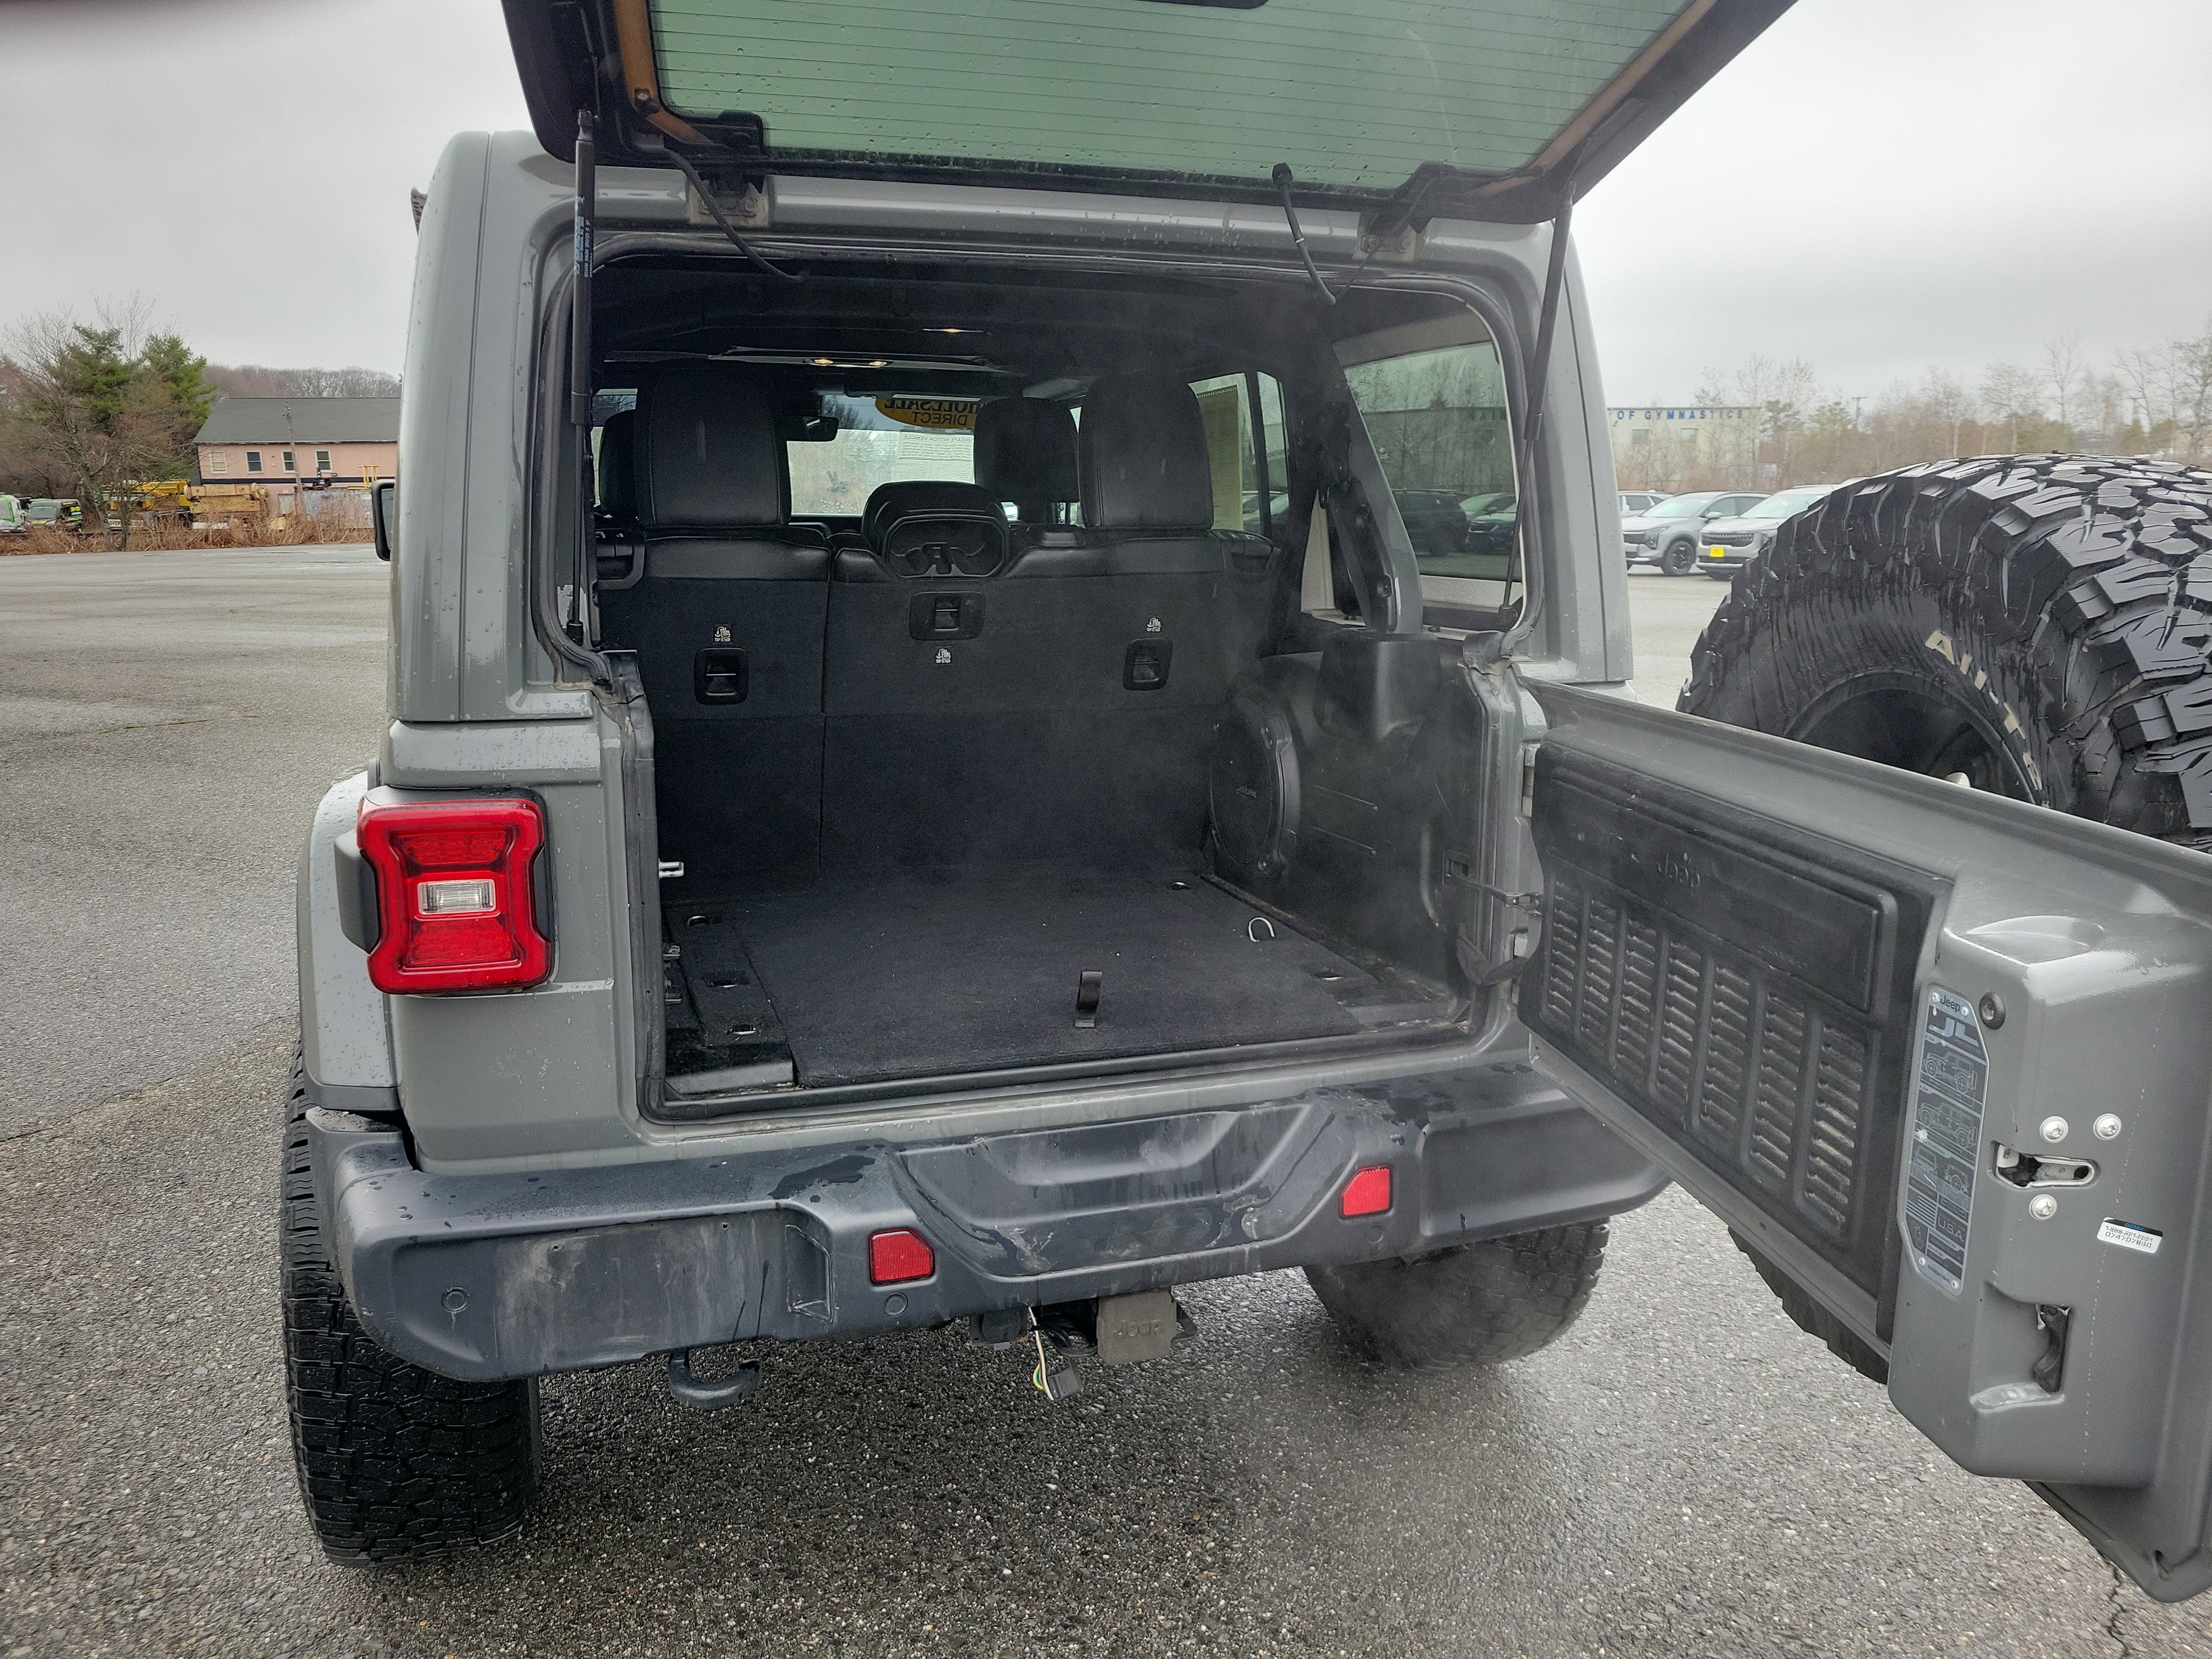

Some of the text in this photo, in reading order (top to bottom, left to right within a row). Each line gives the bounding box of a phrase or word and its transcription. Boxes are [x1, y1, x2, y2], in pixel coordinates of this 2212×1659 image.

[1617, 410, 1743, 420] OF GYMNASTICS
[1657, 851, 1701, 891] Jeep
[1940, 995, 1961, 1013] Jeep
[1928, 1017, 1980, 1048] JL
[1938, 1216, 1965, 1243] USA
